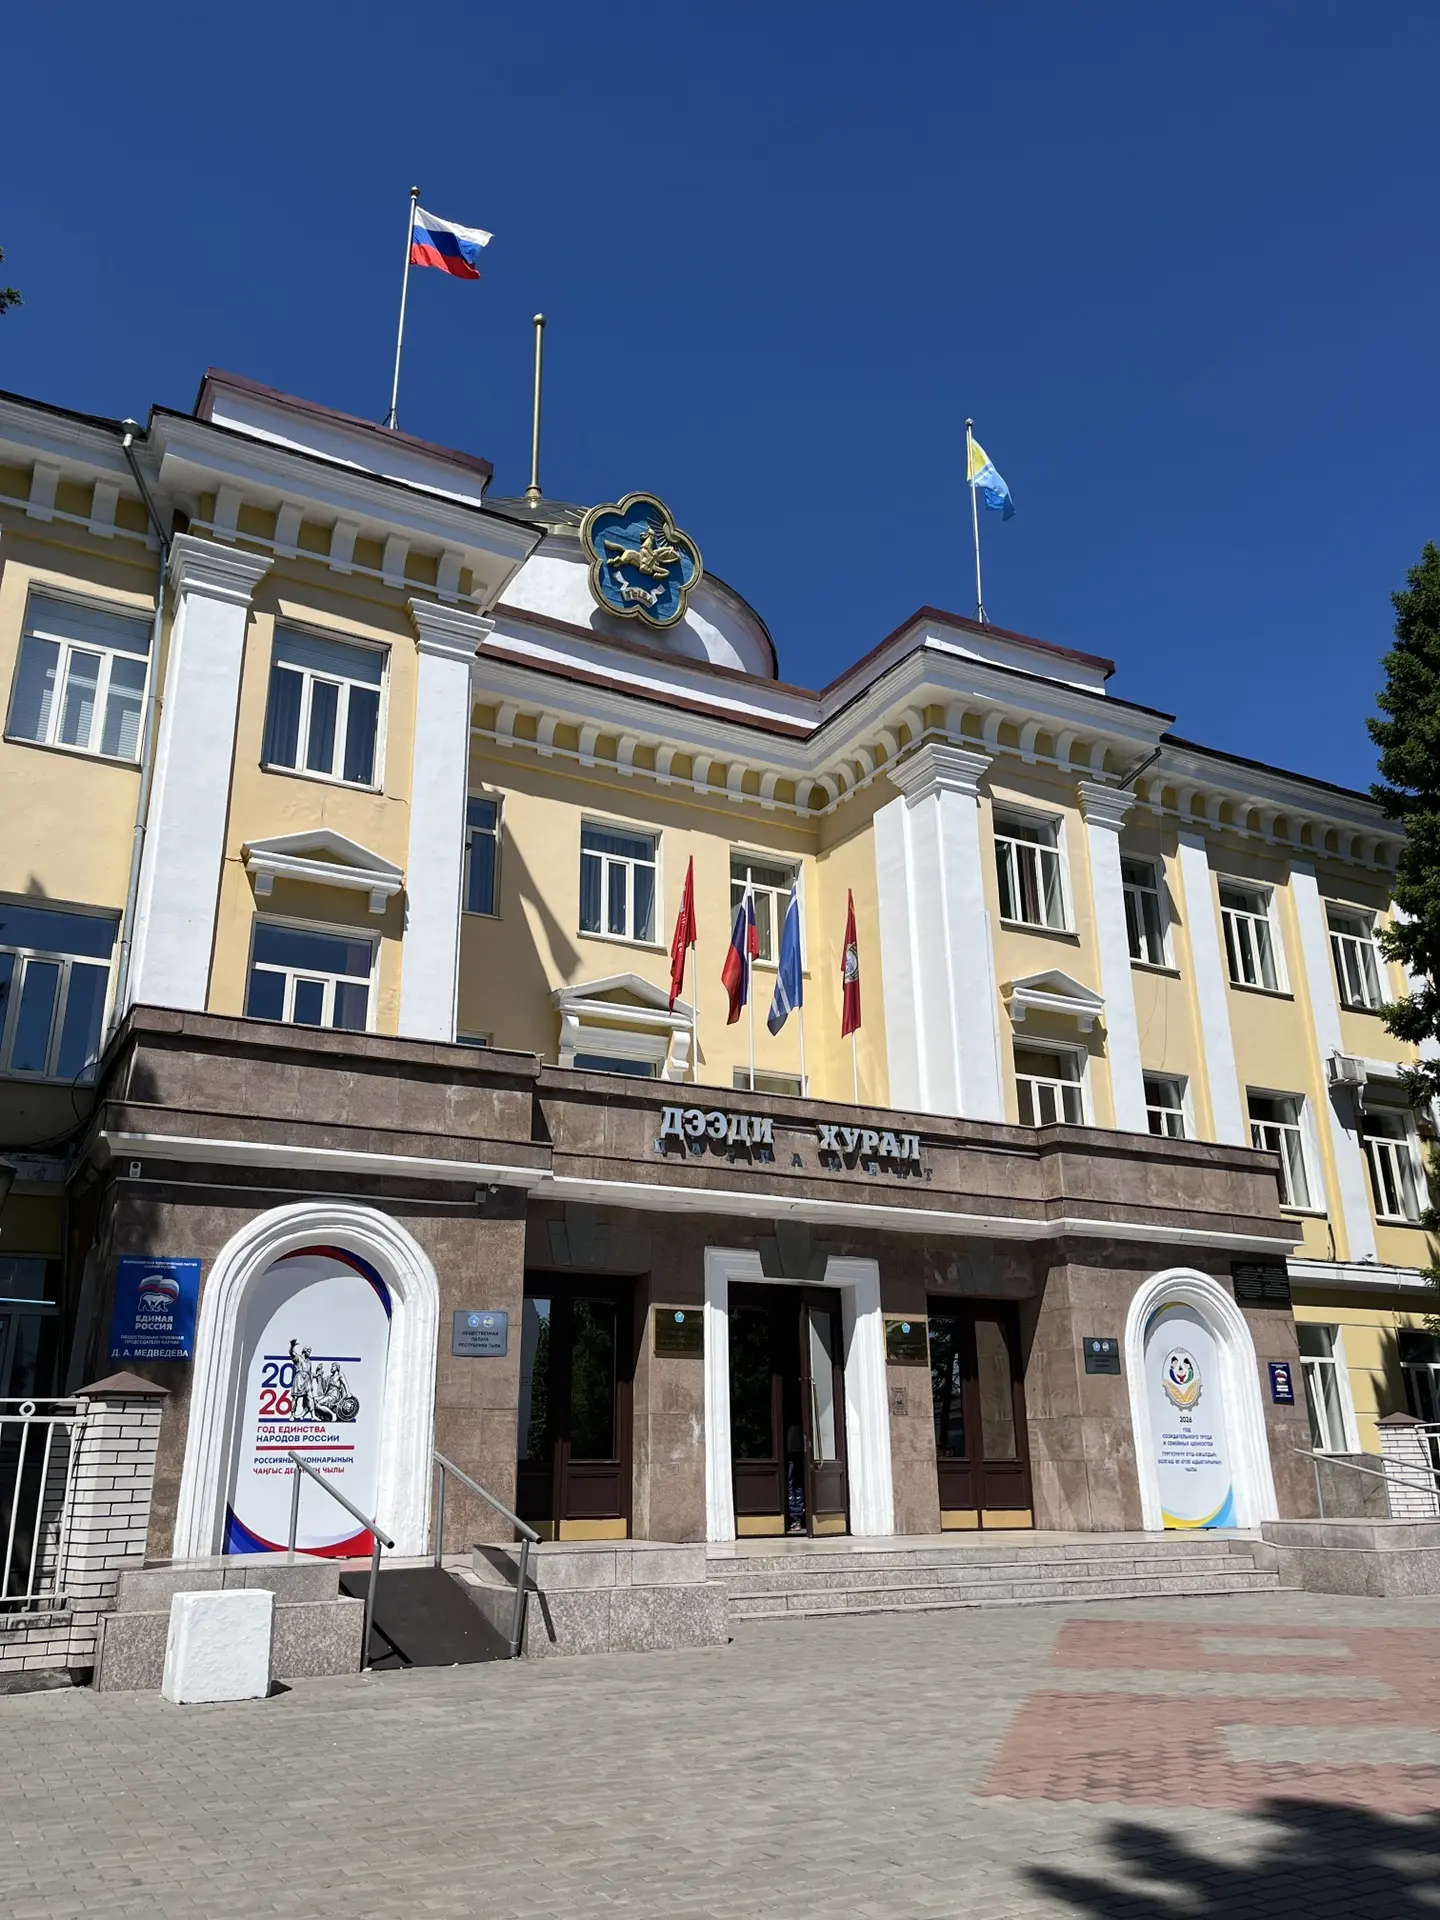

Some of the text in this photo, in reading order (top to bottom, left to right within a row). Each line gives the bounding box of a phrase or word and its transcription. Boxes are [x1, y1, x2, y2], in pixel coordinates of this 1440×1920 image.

[660, 1106, 920, 1160] ДЭЭДИ ХУРАЛ
[262, 1362, 296, 1388] 20
[258, 1389, 293, 1415] 26
